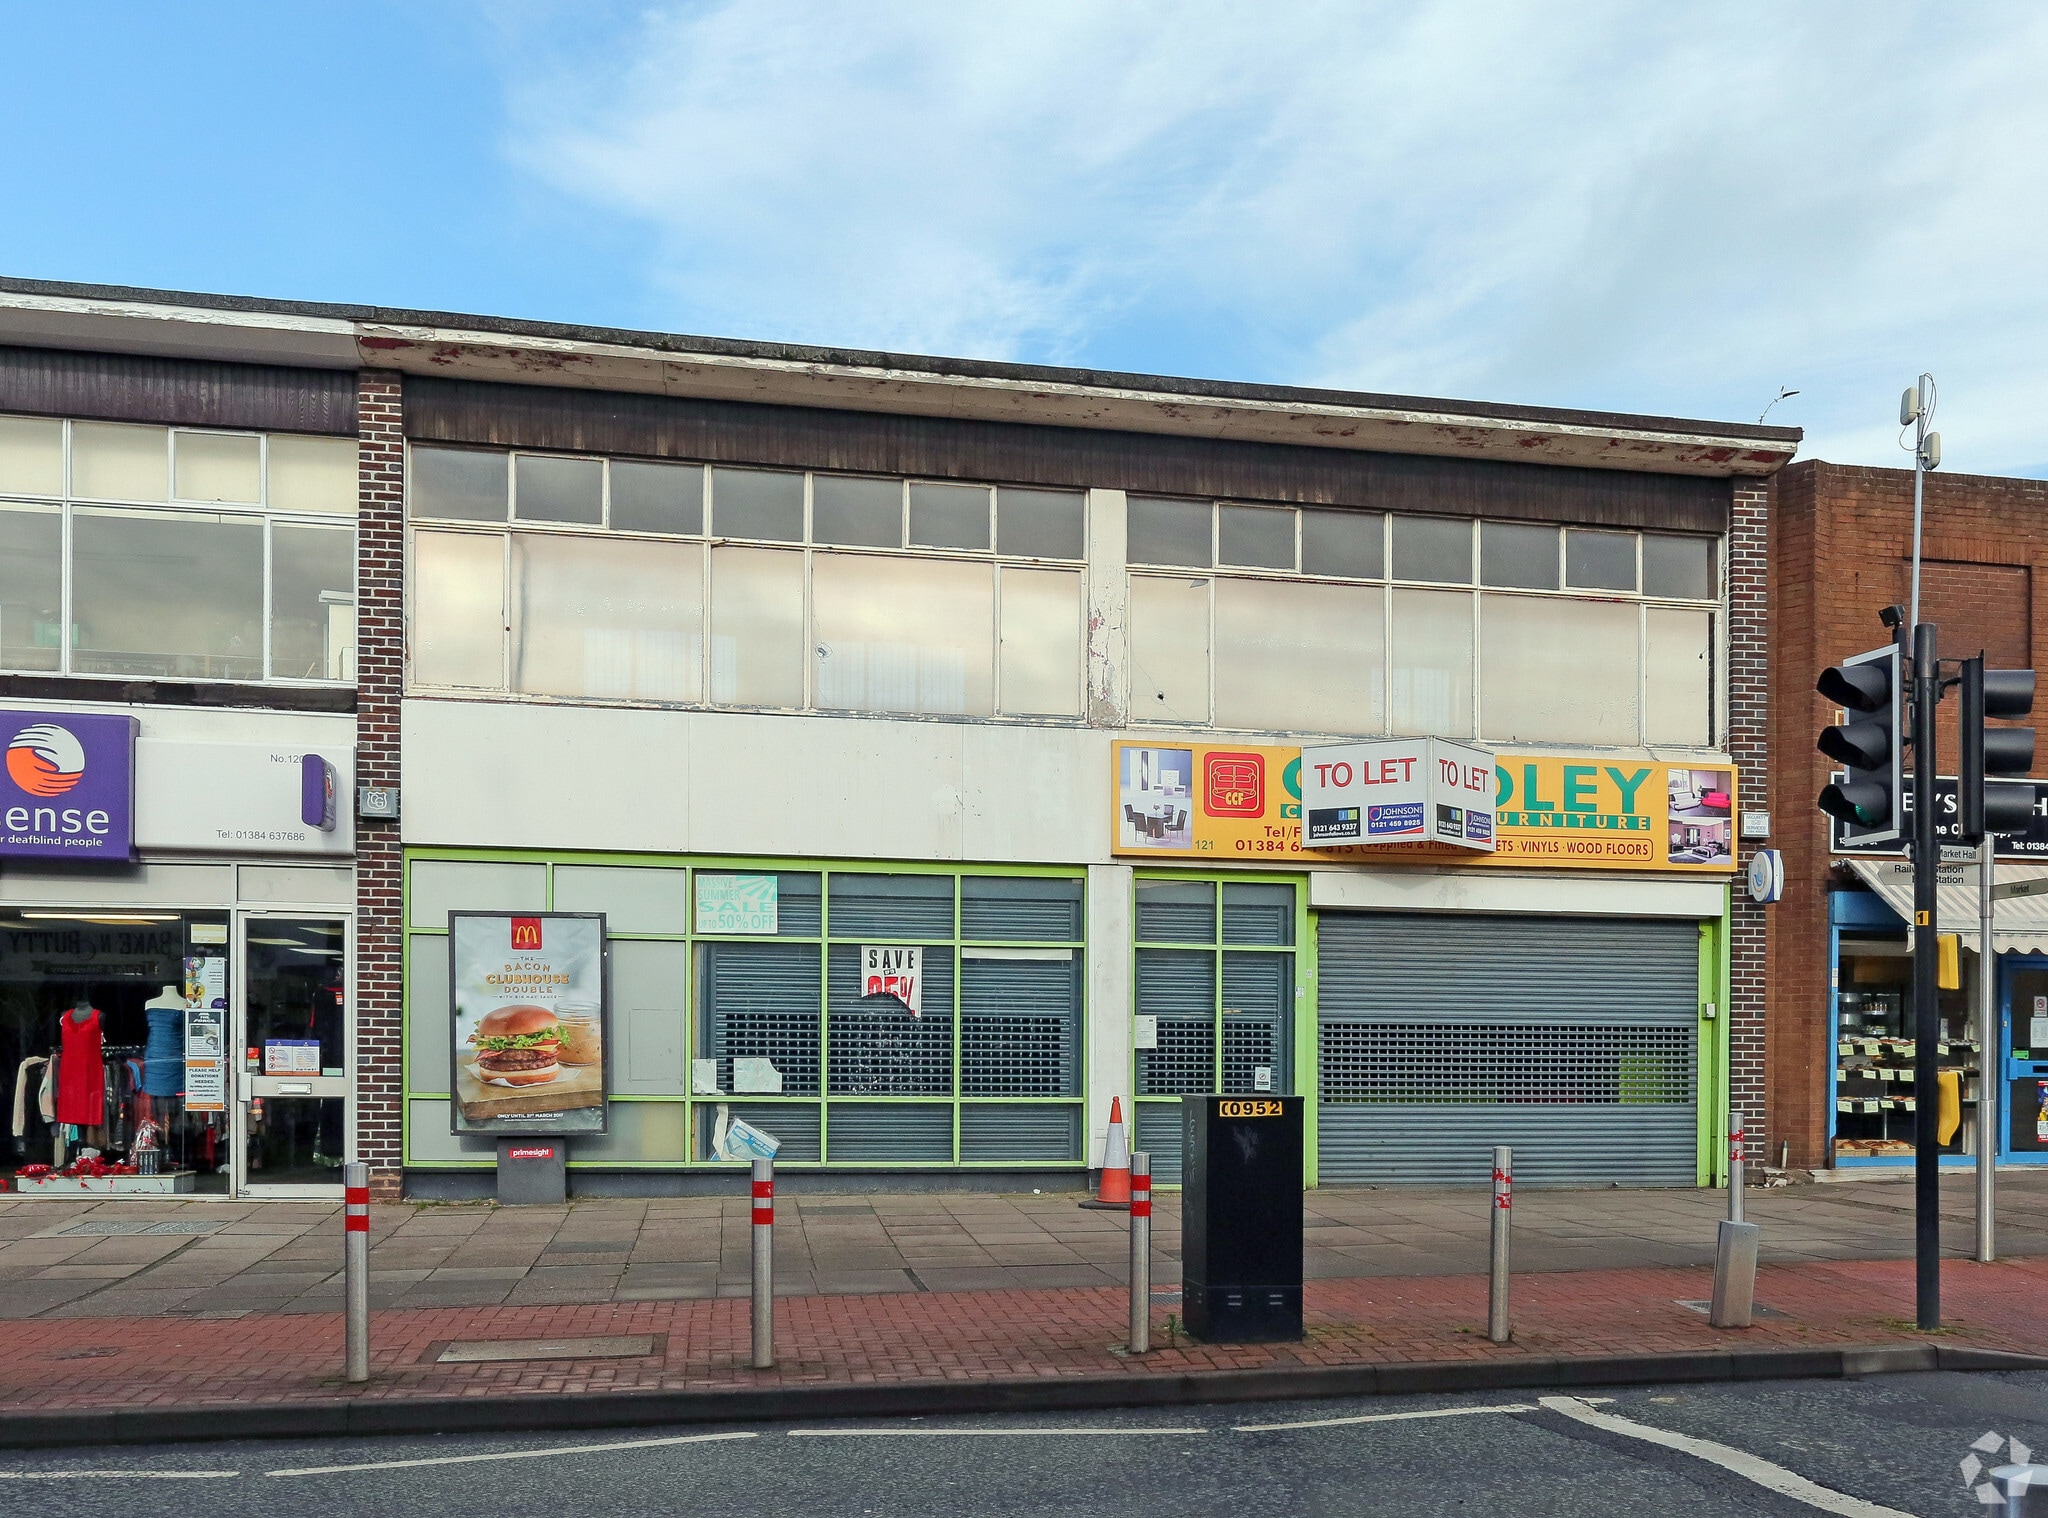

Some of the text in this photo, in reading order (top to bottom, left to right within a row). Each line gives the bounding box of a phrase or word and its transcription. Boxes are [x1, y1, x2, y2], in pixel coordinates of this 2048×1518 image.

[1314, 761, 1353, 788] TO
[1363, 757, 1417, 785] LET
[1439, 758, 1489, 793] TO LET
[1225, 791, 1244, 806] CCF
[0, 806, 110, 834] ense
[1497, 812, 1648, 830] URNITURE
[1264, 825, 1302, 840] Tel/F
[1312, 822, 1357, 833] 0121 643 9337
[8, 834, 61, 845] deafblind
[64, 837, 103, 848] people
[216, 829, 305, 841] Tel: 01384 637686
[1195, 839, 1214, 850] 121
[1235, 839, 1285, 851] 01384
[1520, 840, 1559, 853] VINYLS
[1566, 841, 1603, 855] WOOD
[1606, 843, 1649, 856] FLOORS
[2011, 841, 2025, 850] Tel:
[1962, 850, 1976, 859] Hall
[1894, 864, 1915, 873] Rail
[697, 876, 734, 889] MASSIVE
[698, 889, 740, 901] SUMMER
[698, 901, 775, 913] SALE
[708, 919, 717, 929] TO
[718, 914, 749, 929] 50%
[751, 914, 775, 929] OFF
[1917, 912, 1924, 924] 1
[868, 949, 914, 969] SAVE
[504, 962, 551, 973] BACON
[485, 973, 570, 985] CLUBHOUSE
[504, 986, 553, 994] DOUBLE
[513, 1148, 549, 1158] primesight
